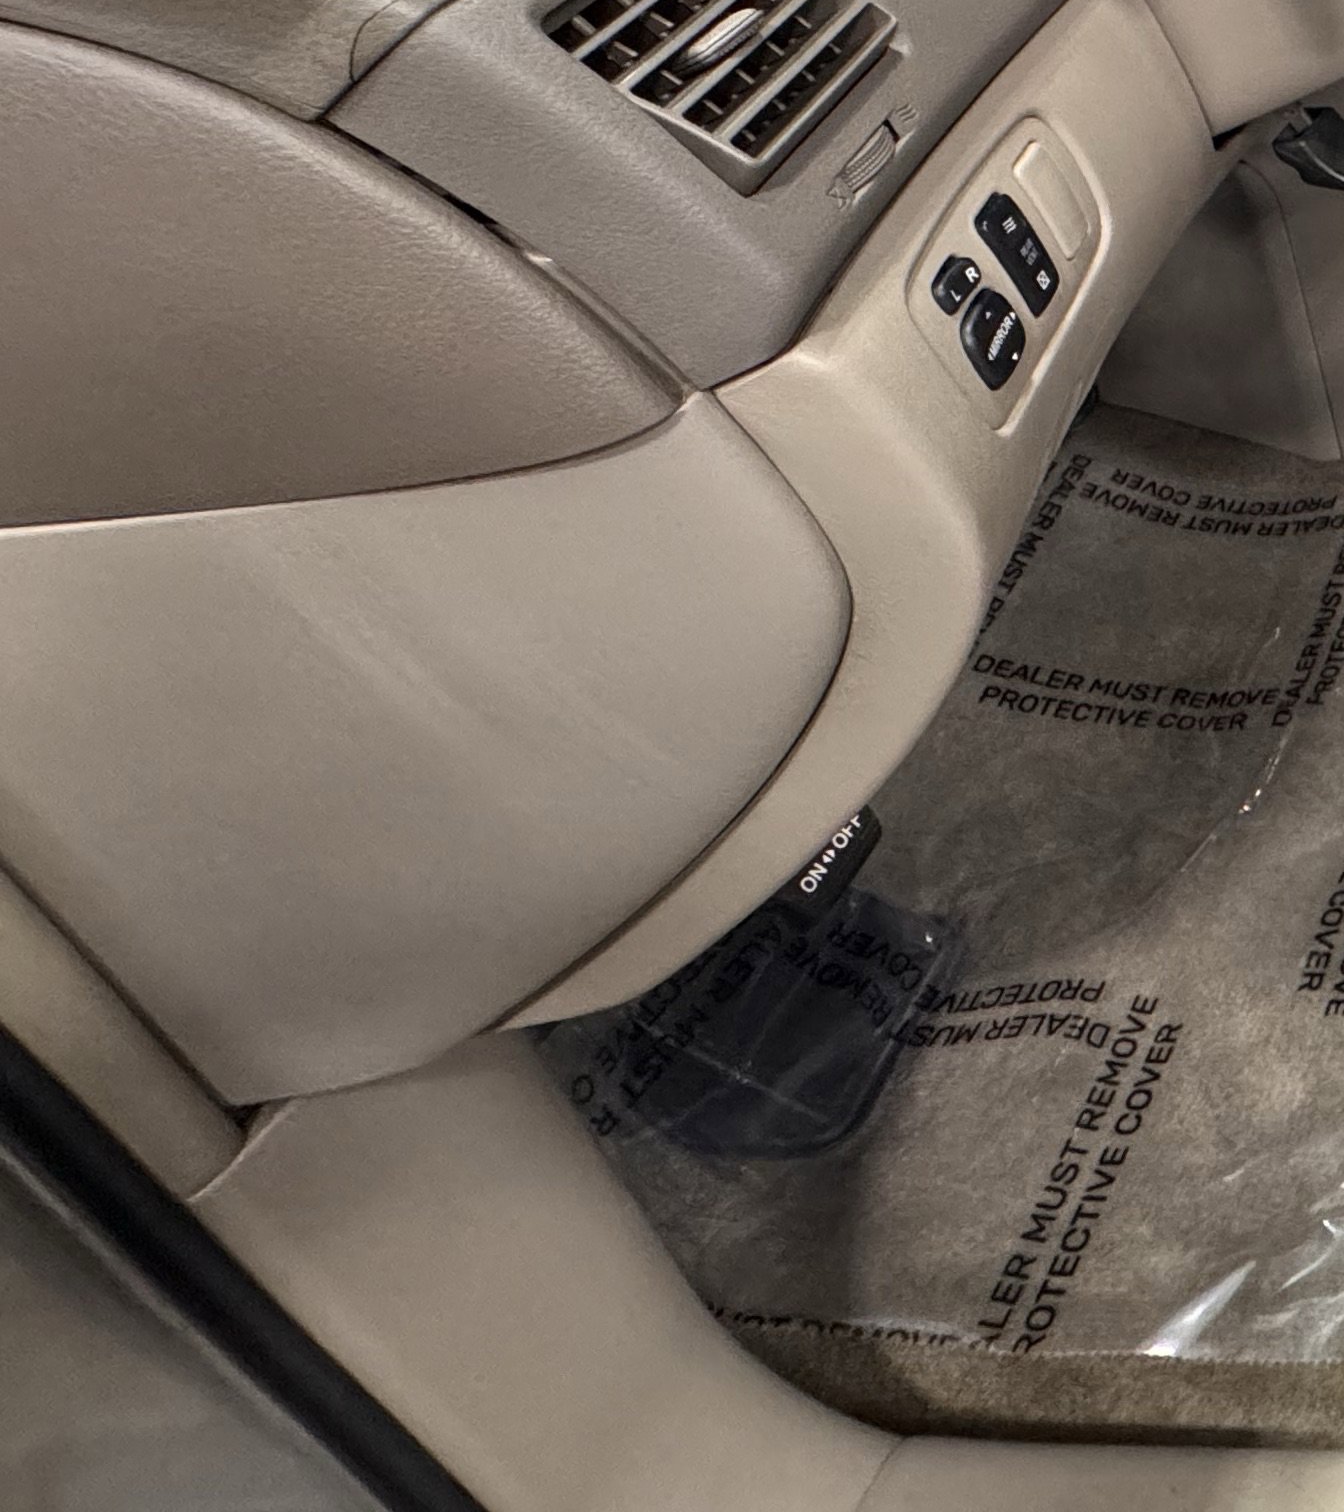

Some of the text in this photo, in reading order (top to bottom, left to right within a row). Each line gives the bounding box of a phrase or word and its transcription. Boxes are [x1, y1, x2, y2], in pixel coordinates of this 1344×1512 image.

[950, 289, 961, 302] L
[965, 266, 979, 283] R
[991, 316, 1014, 357] MIRROR
[1080, 481, 1180, 527] REMOVE
[1109, 468, 1339, 516] PROTECTIVE COVER
[998, 454, 1092, 594] DEALER MUST
[1181, 516, 1252, 536] MUST
[1310, 579, 1344, 639] MUST
[972, 653, 1281, 710] DEALER MUST REMOVE
[978, 685, 1250, 732] PROTECTIVE COVER
[800, 862, 828, 893] ON
[915, 979, 1106, 1014] PROTECTIVE
[887, 1021, 984, 1049] MUST
[985, 1012, 1111, 1050] DEALER
[1114, 1022, 1184, 1136] COVER
[1021, 1138, 1089, 1243] MUST
[1076, 994, 1159, 1132] REMOVE
